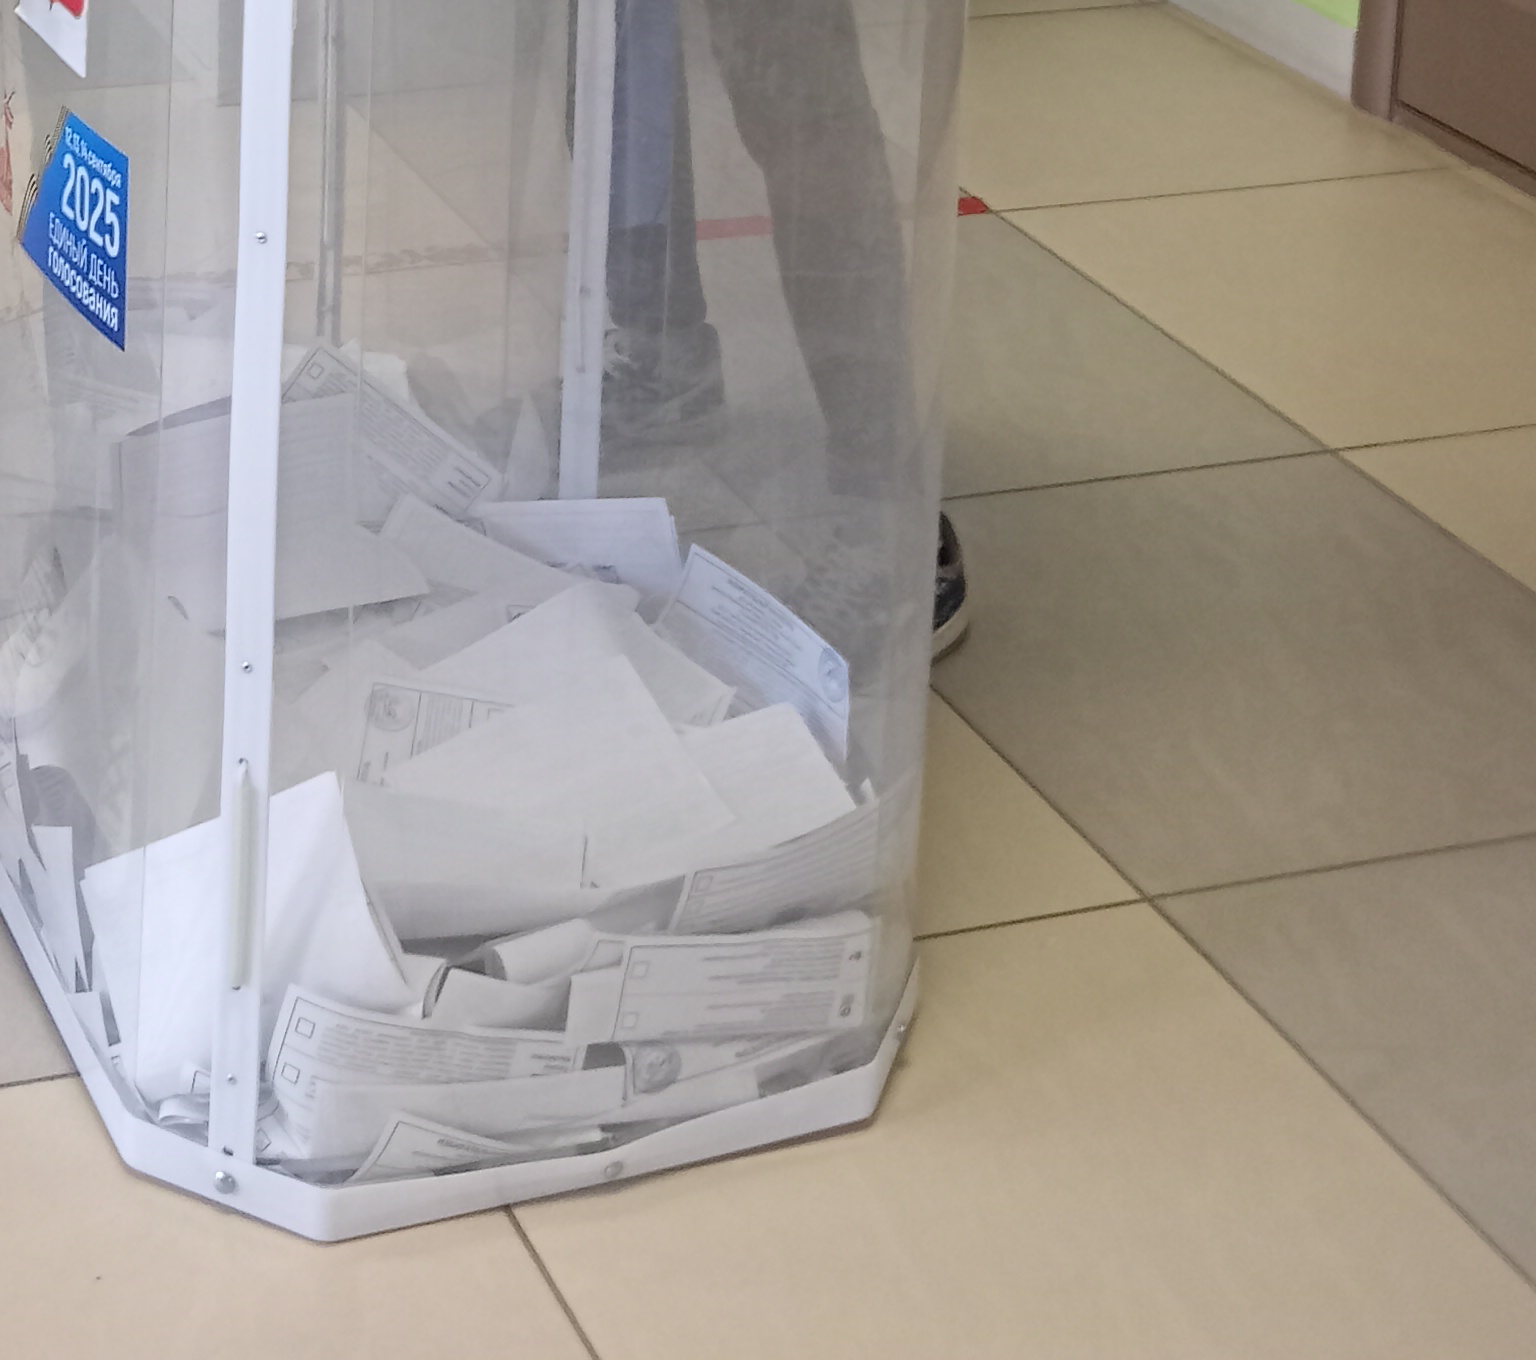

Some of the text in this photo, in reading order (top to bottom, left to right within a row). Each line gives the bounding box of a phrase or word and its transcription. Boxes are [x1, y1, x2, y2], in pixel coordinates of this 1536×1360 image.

[60, 153, 120, 258] 2025
[47, 246, 119, 332] голосования
[48, 211, 120, 298] ЕДИНЫЙ ДЕНЬ
